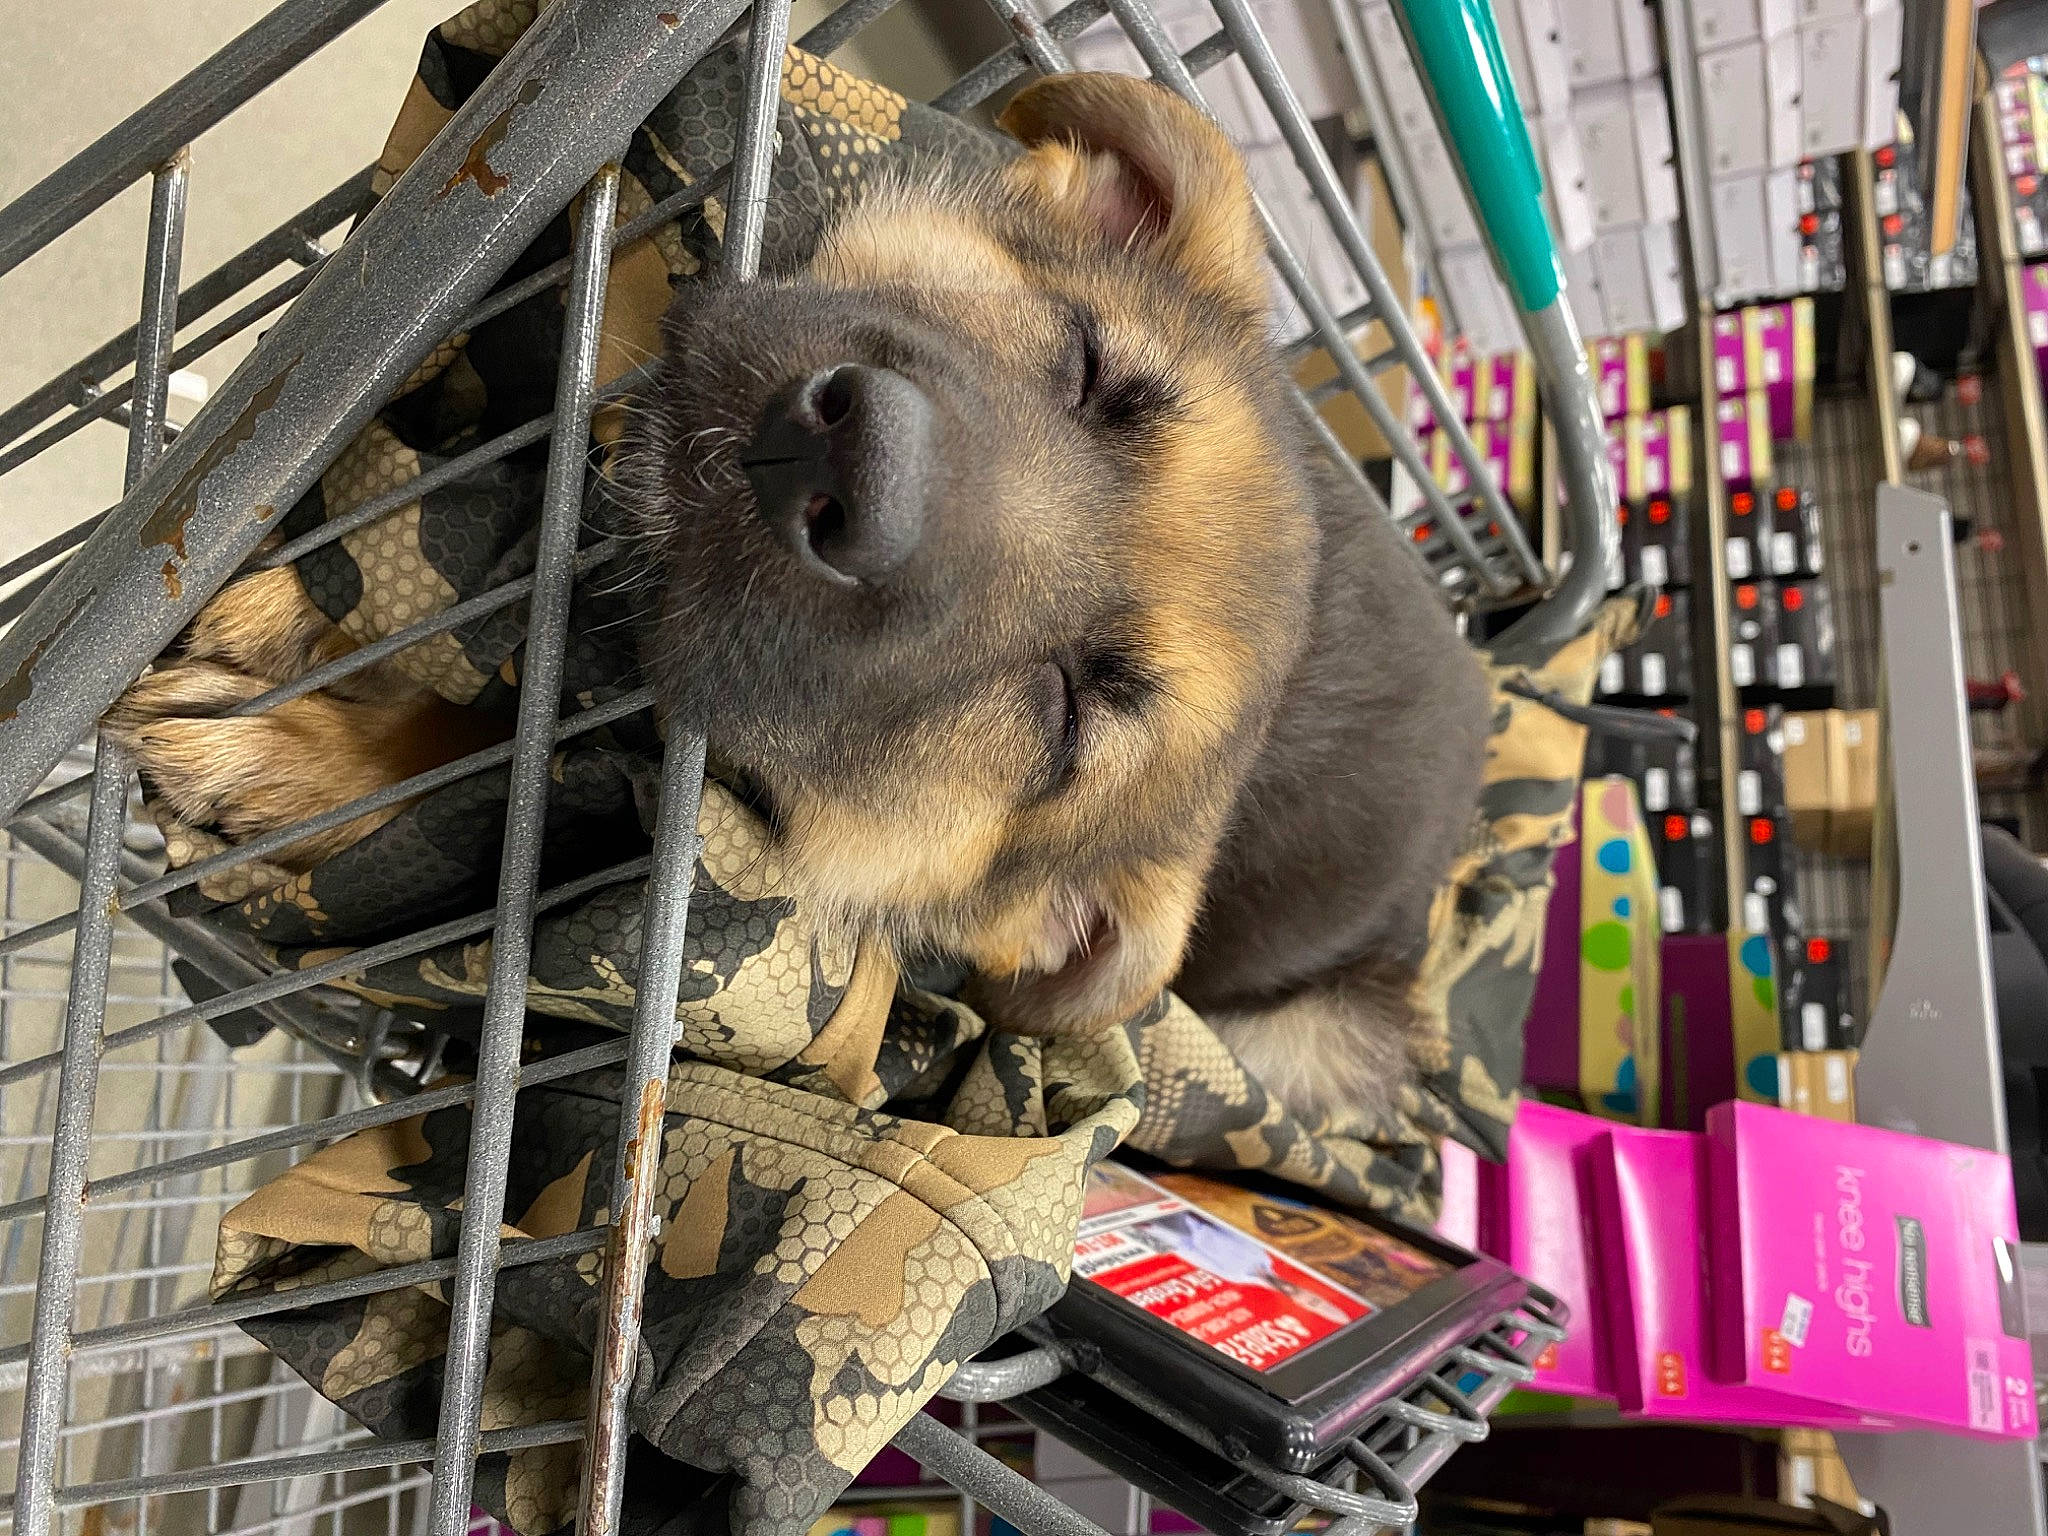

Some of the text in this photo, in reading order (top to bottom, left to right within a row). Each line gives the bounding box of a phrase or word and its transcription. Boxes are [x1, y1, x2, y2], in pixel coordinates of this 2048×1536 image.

[1834, 1165, 1878, 1358] knee highs
[1228, 1319, 1303, 1359] State
[2005, 1376, 2027, 1397] 2
